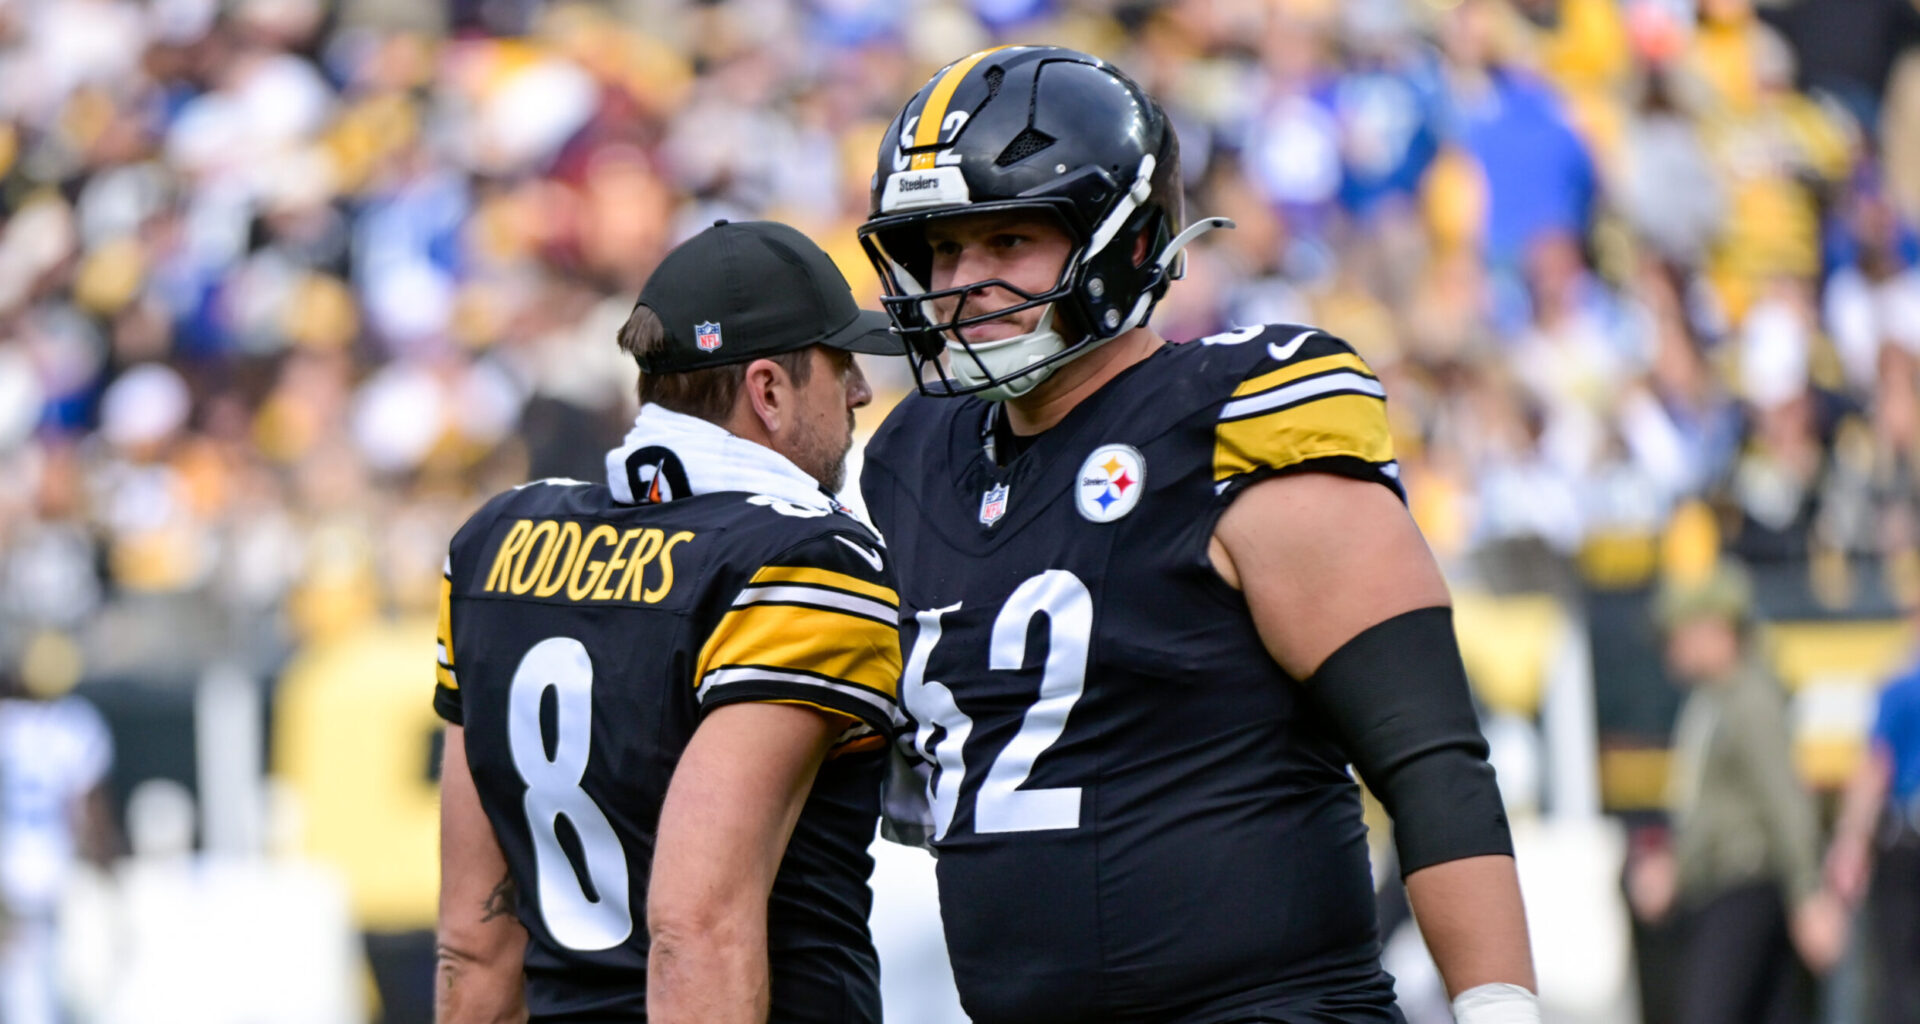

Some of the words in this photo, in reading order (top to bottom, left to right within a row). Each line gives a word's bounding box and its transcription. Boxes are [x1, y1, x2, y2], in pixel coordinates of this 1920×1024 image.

[899, 175, 939, 192] Steelers
[700, 334, 720, 348] NFL
[484, 519, 695, 604] RODGERS
[902, 569, 1093, 842] 62
[507, 637, 633, 951] 8
